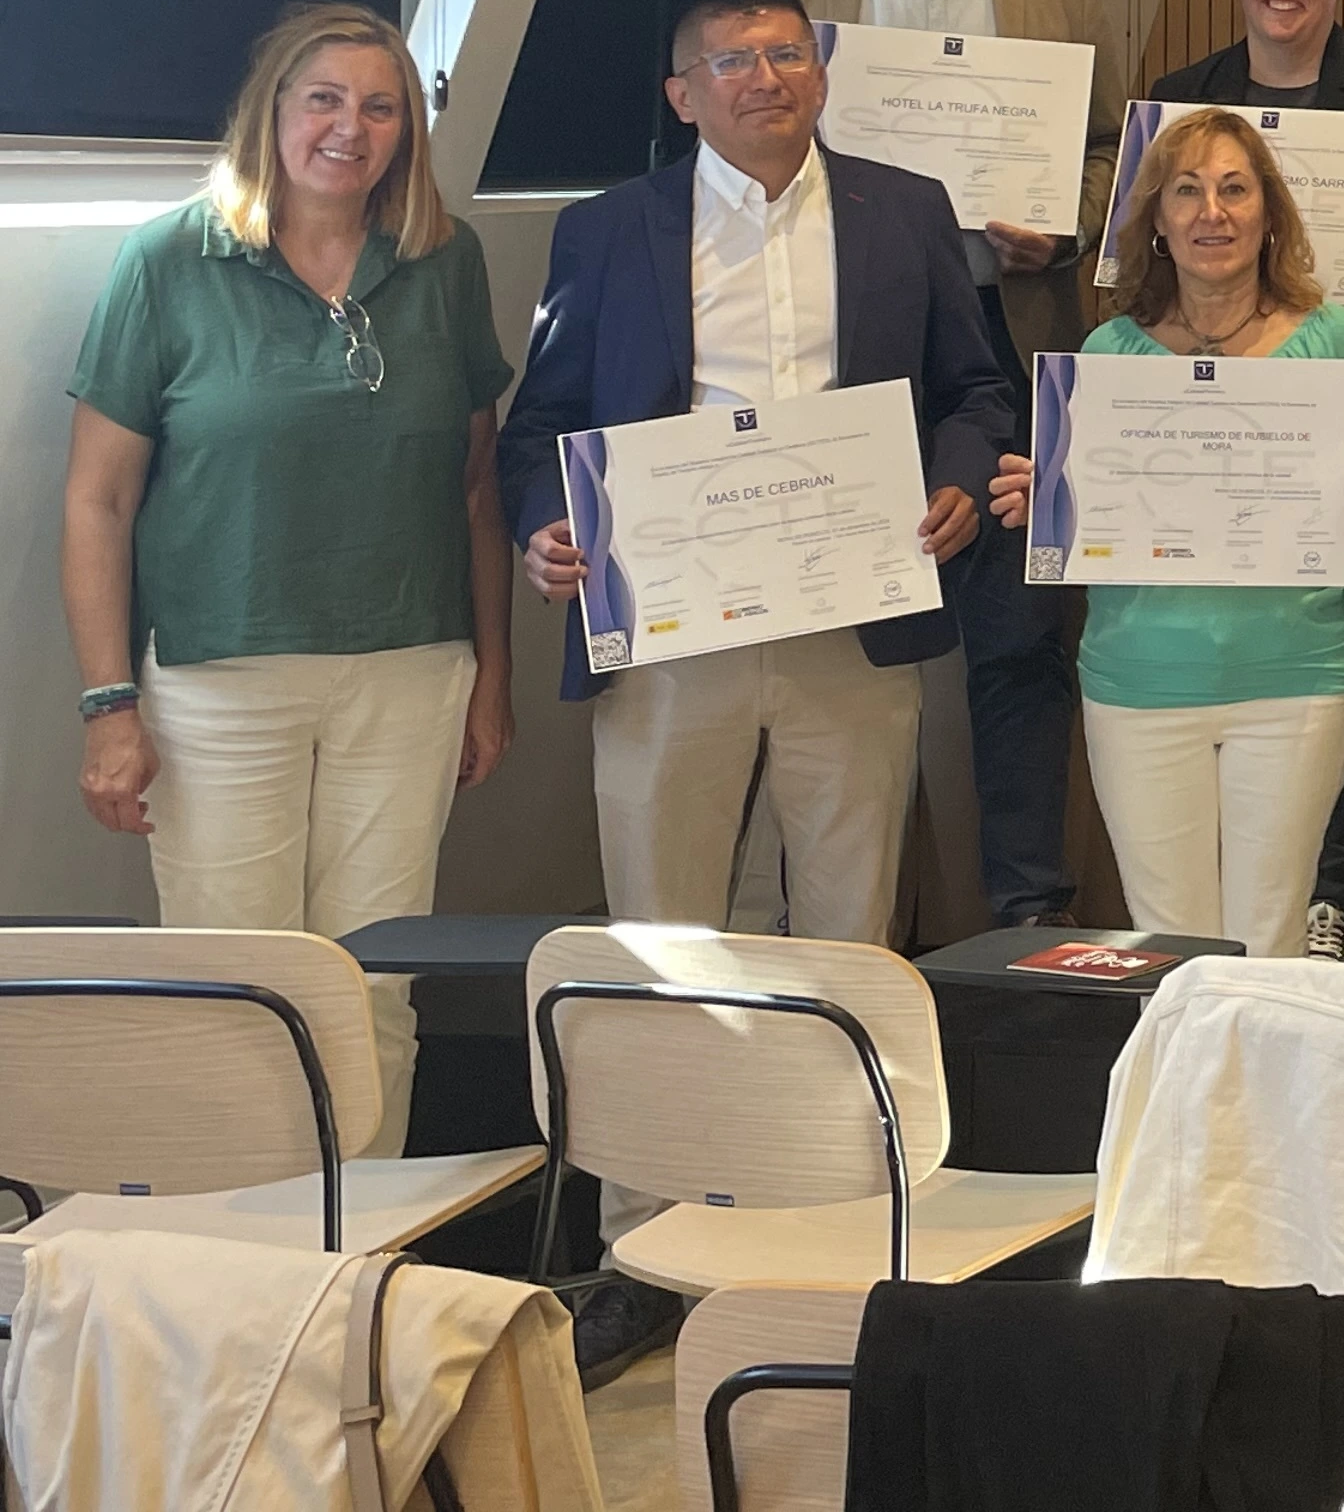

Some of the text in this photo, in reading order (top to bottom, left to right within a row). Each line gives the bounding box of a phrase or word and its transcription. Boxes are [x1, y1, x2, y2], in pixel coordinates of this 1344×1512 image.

[881, 96, 1038, 119] HOTEL LA TRUFA NEGRA
[1120, 430, 1161, 439] OFICINA
[1164, 431, 1177, 439] DE
[1181, 431, 1226, 440] TURISMO
[1228, 432, 1242, 440] DE
[1297, 433, 1312, 442] DE
[1202, 442, 1233, 451] MORA
[706, 490, 740, 506] MAS
[743, 486, 765, 500] DE
